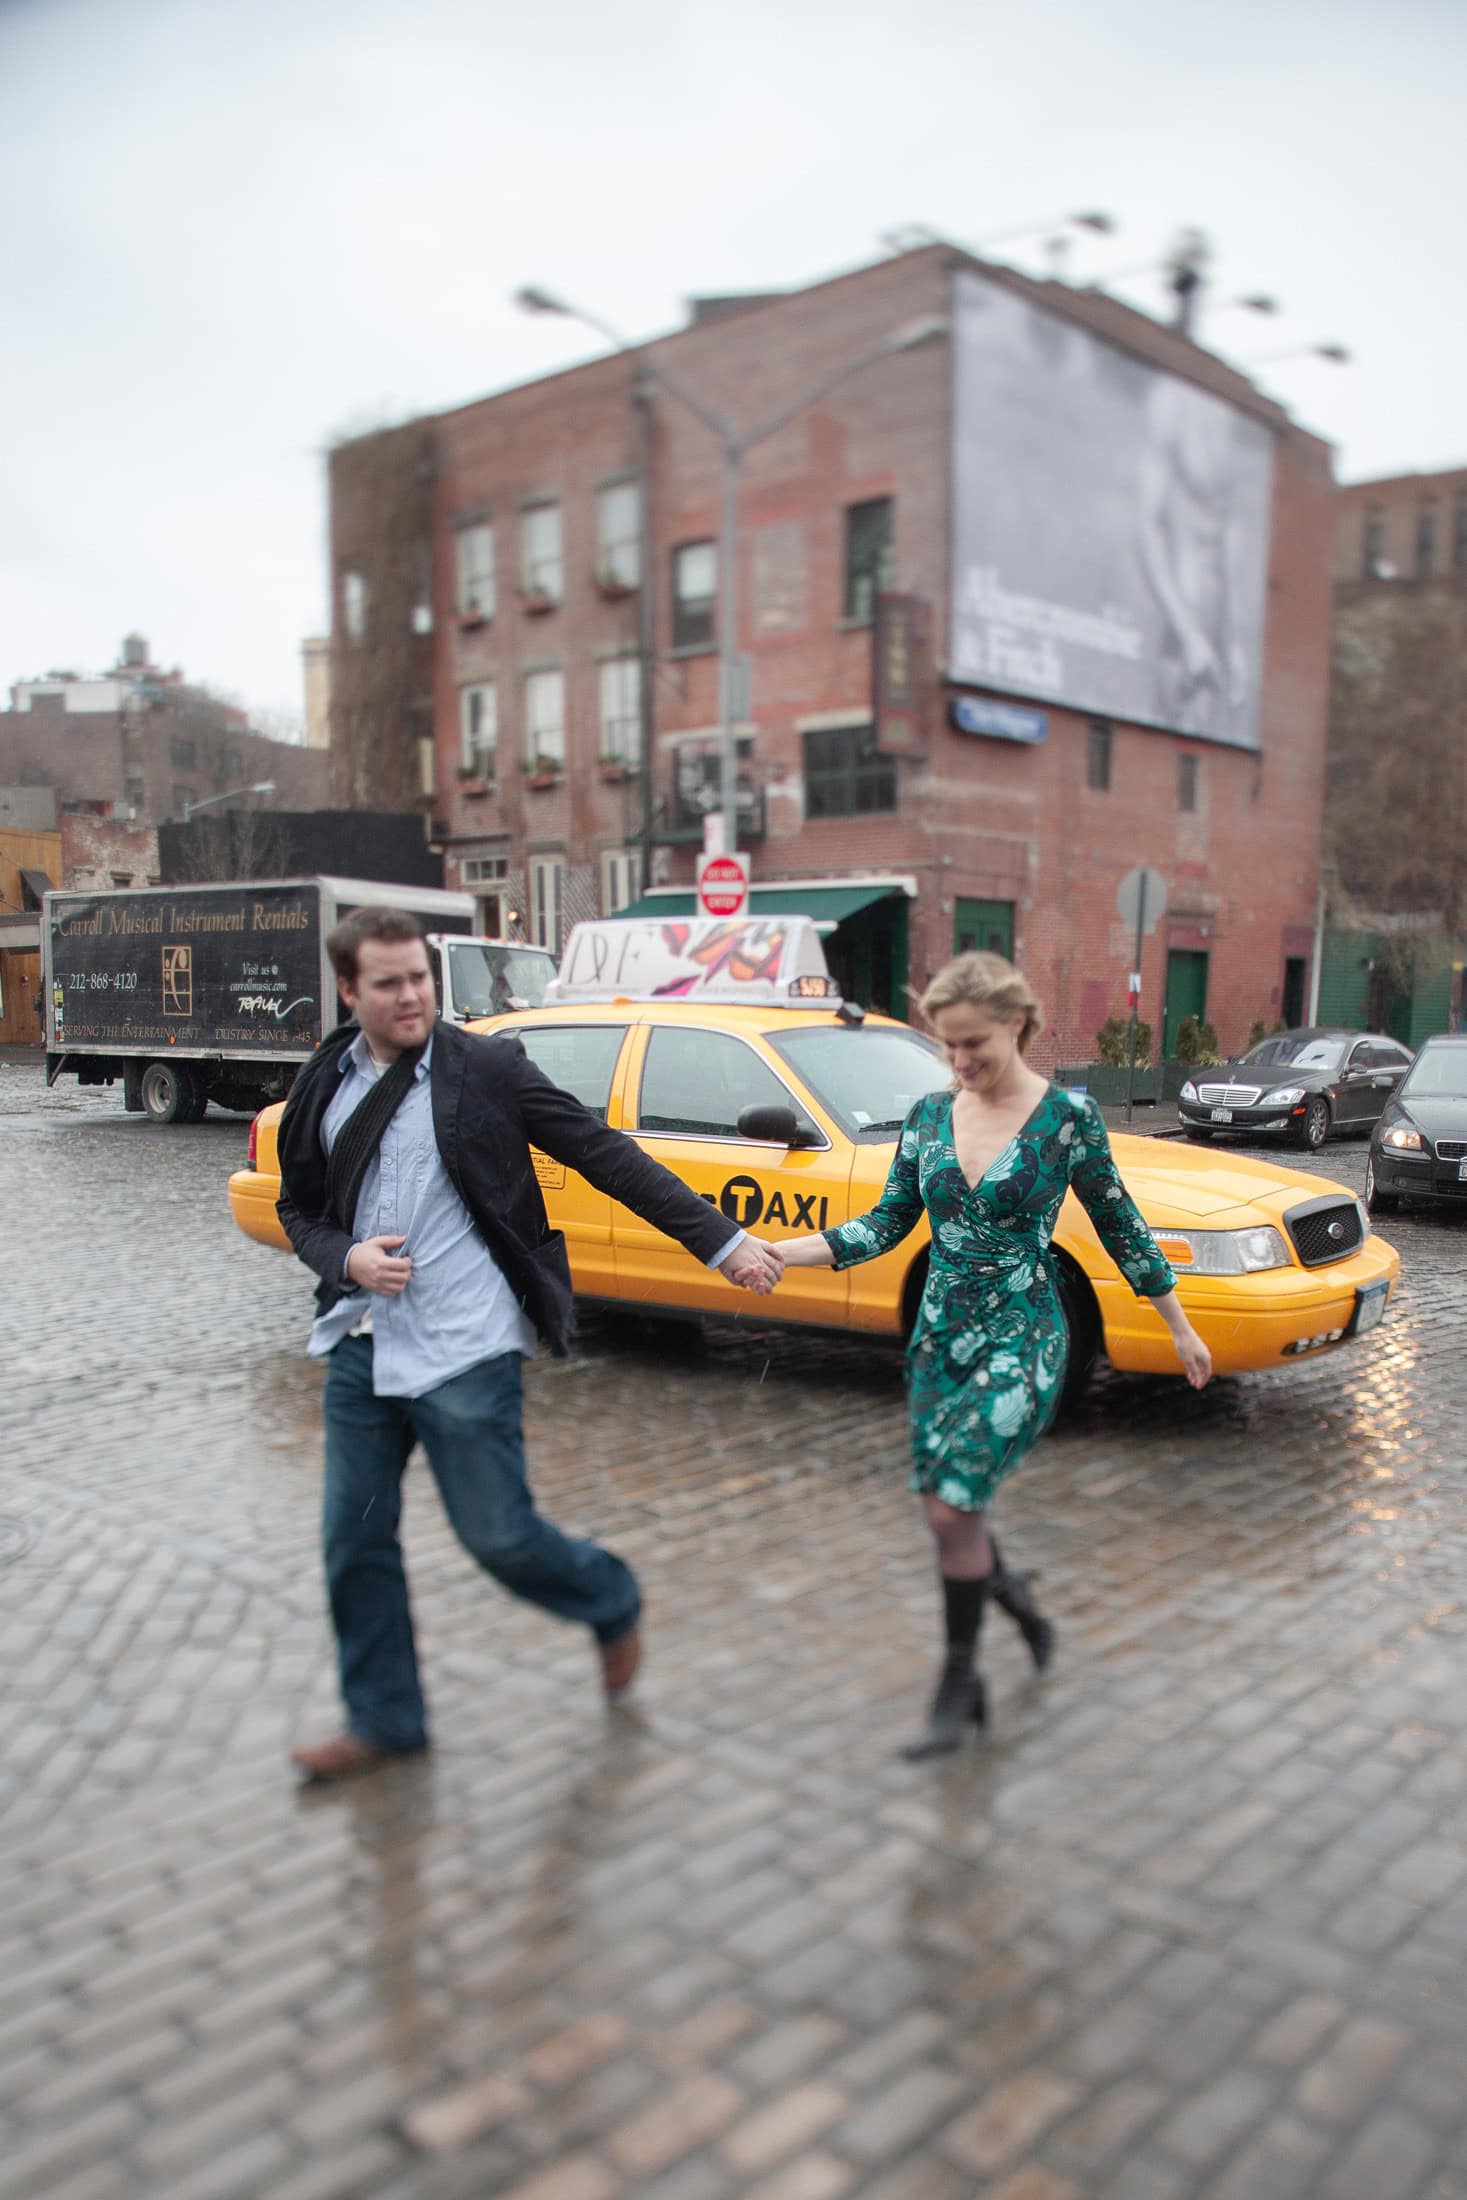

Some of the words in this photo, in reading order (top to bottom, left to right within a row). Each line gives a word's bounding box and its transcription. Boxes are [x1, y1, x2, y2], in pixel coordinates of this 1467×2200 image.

[59, 910, 103, 937] Carroll
[110, 907, 165, 935] Musical
[169, 906, 246, 933] Instrument
[252, 901, 309, 931] Rentals
[242, 961, 259, 976] Visit
[69, 972, 138, 990] 212-868-4120
[229, 977, 288, 993] carrollmusic.com
[63, 1024, 99, 1037] SERVING
[101, 1025, 118, 1038] THE
[121, 1025, 200, 1040] ENTERTAINMENT
[258, 1028, 289, 1042] SINCE
[724, 1177, 828, 1231] TAXI
